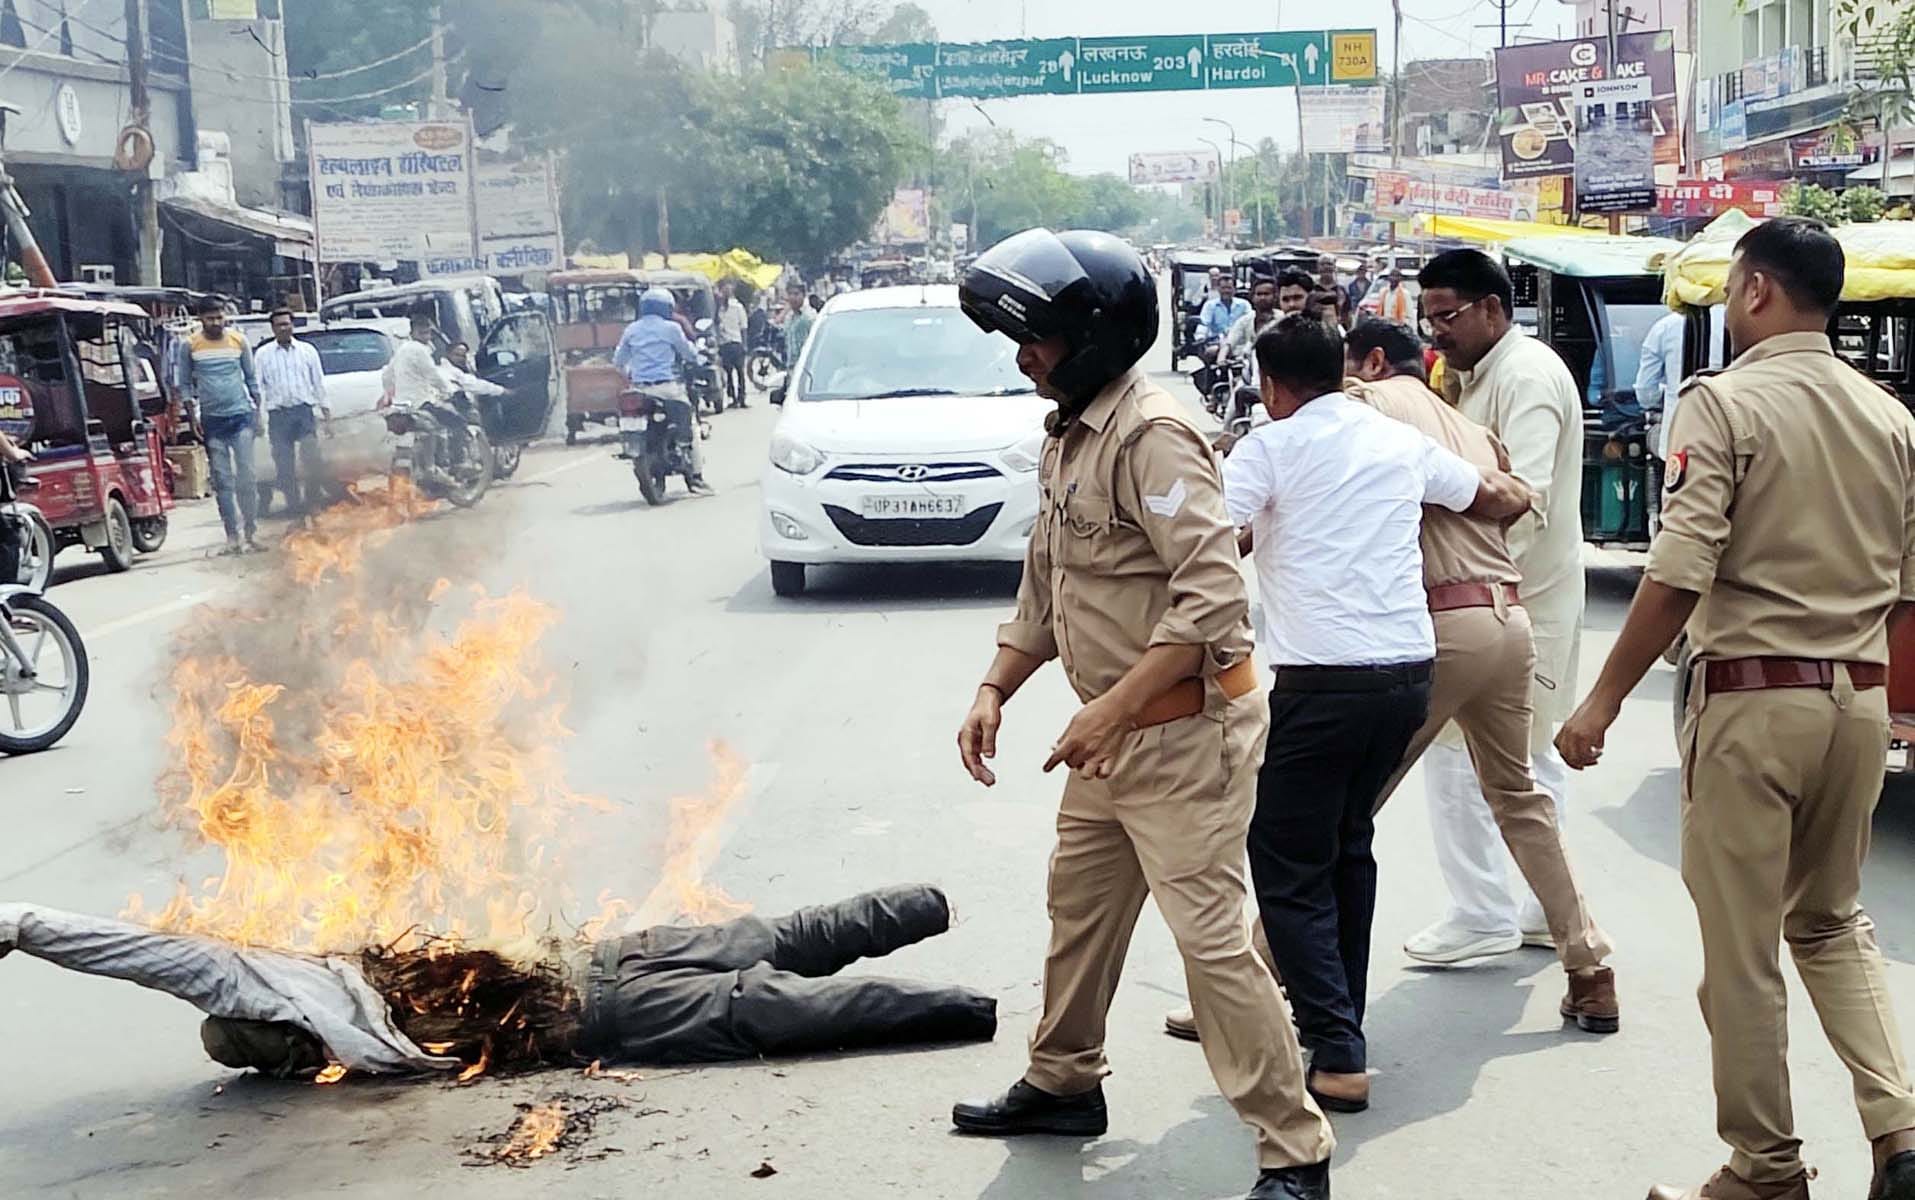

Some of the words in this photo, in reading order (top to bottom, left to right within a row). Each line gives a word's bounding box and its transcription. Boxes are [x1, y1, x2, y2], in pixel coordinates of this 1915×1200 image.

[1082, 45, 1148, 63] लखनऊ
[1212, 38, 1261, 60] हरदोई
[1344, 42, 1362, 52] NH
[1153, 57, 1185, 71] 203
[1337, 56, 1367, 66] 730A
[1083, 69, 1153, 85] Lucknow
[1212, 65, 1266, 80] Hardoi
[1591, 66, 1603, 80] &
[1616, 62, 1645, 78] AKE
